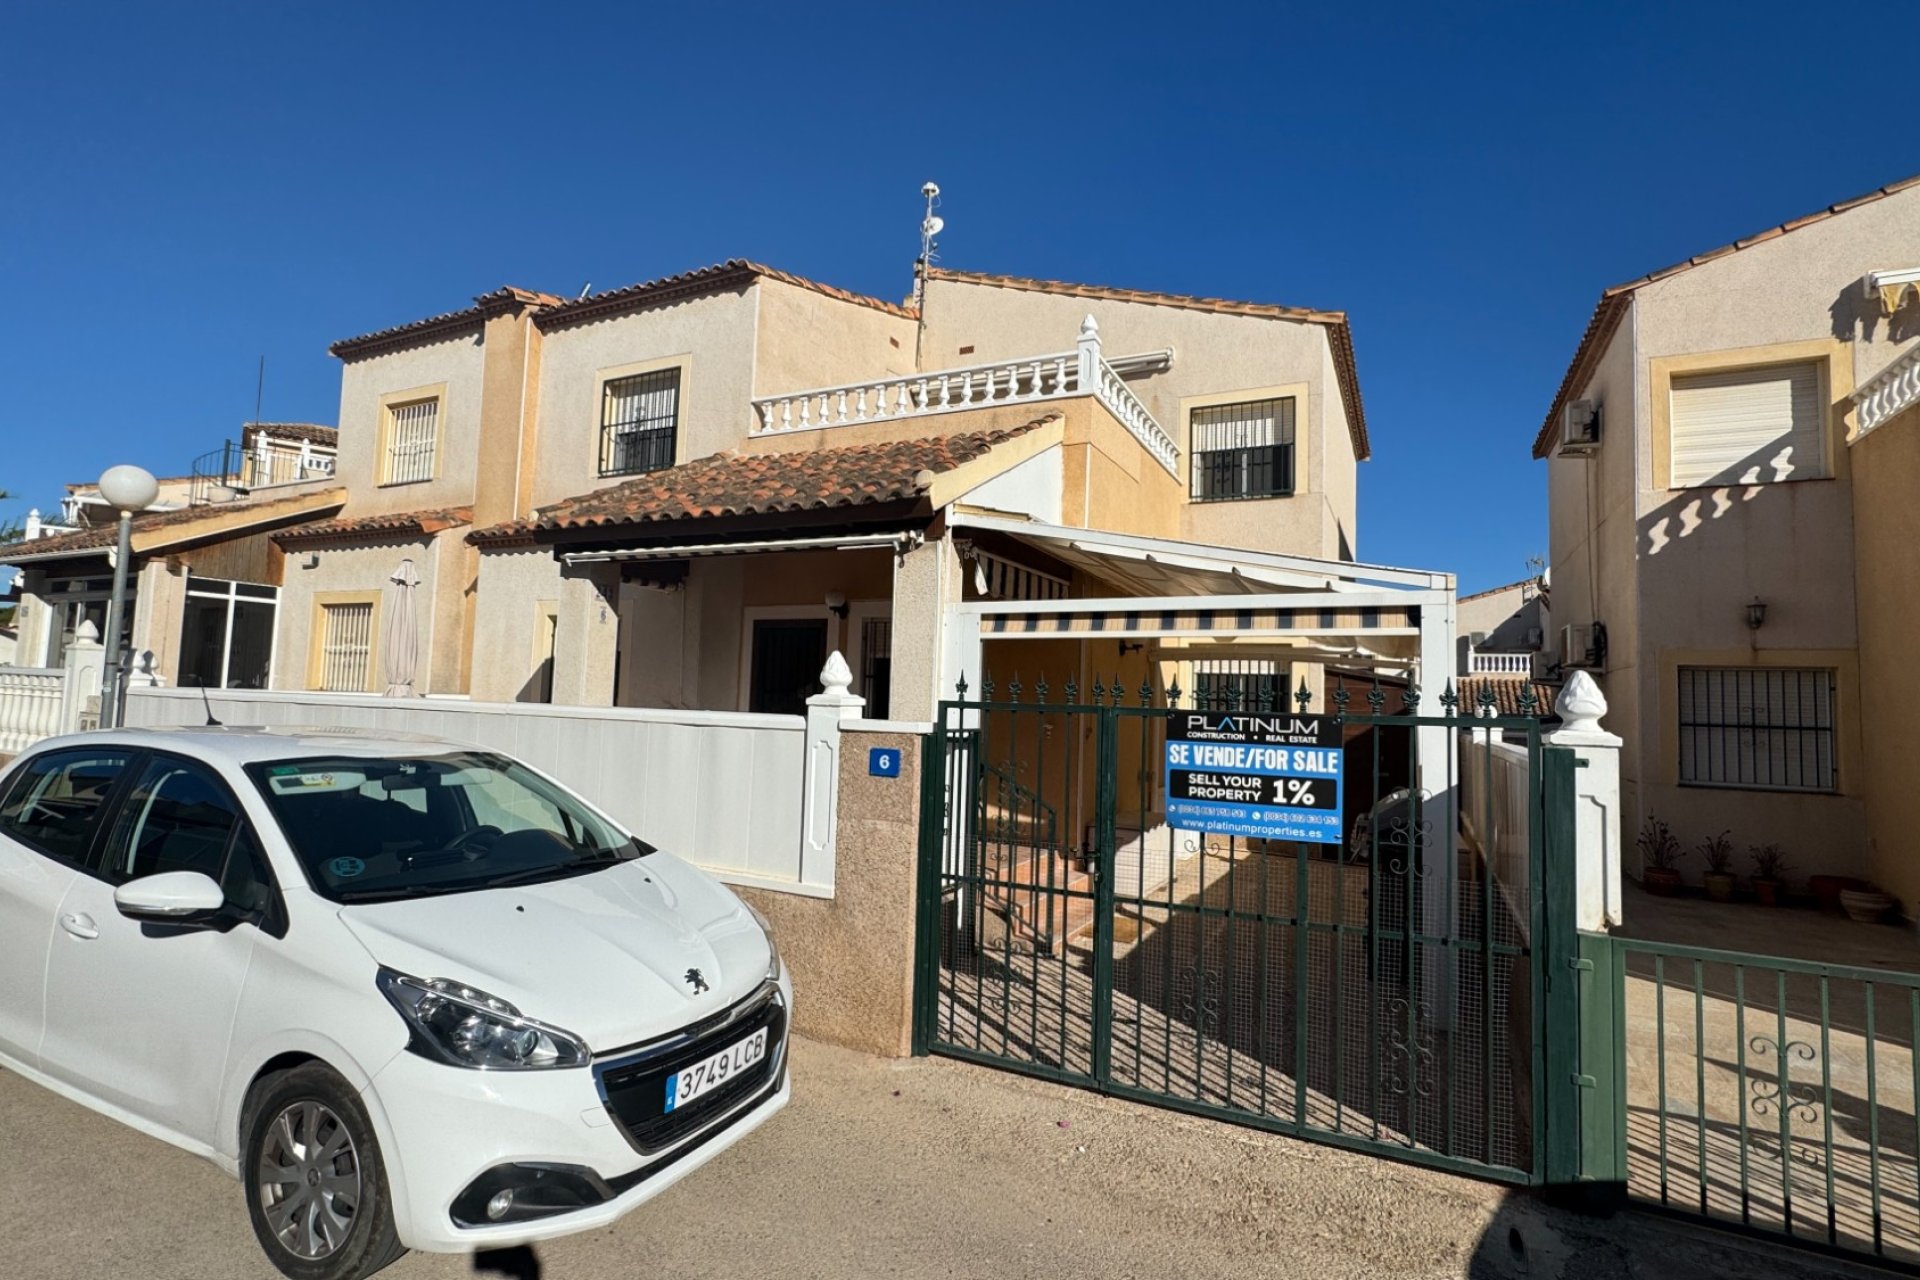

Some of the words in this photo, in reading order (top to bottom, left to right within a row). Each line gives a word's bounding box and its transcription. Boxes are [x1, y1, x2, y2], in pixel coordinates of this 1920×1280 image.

[1187, 715, 1318, 735] PLATINUM
[1187, 731, 1245, 741] CONSTRUCTION
[1265, 735, 1286, 743] REAL
[1289, 736, 1318, 744] ESTATE
[879, 754, 890, 769] 6
[1169, 744, 1189, 765] SE
[1193, 746, 1288, 770] VENDE/FOR
[1293, 751, 1339, 773] SALE
[1188, 773, 1220, 786] SELL
[1222, 775, 1262, 789] YOUR
[1188, 787, 1262, 801] PROPERTY
[1272, 779, 1316, 805] 1%
[1182, 818, 1323, 839] www.platinumproperties.es
[680, 1054, 729, 1099] 3749
[733, 1034, 763, 1071] LCB
